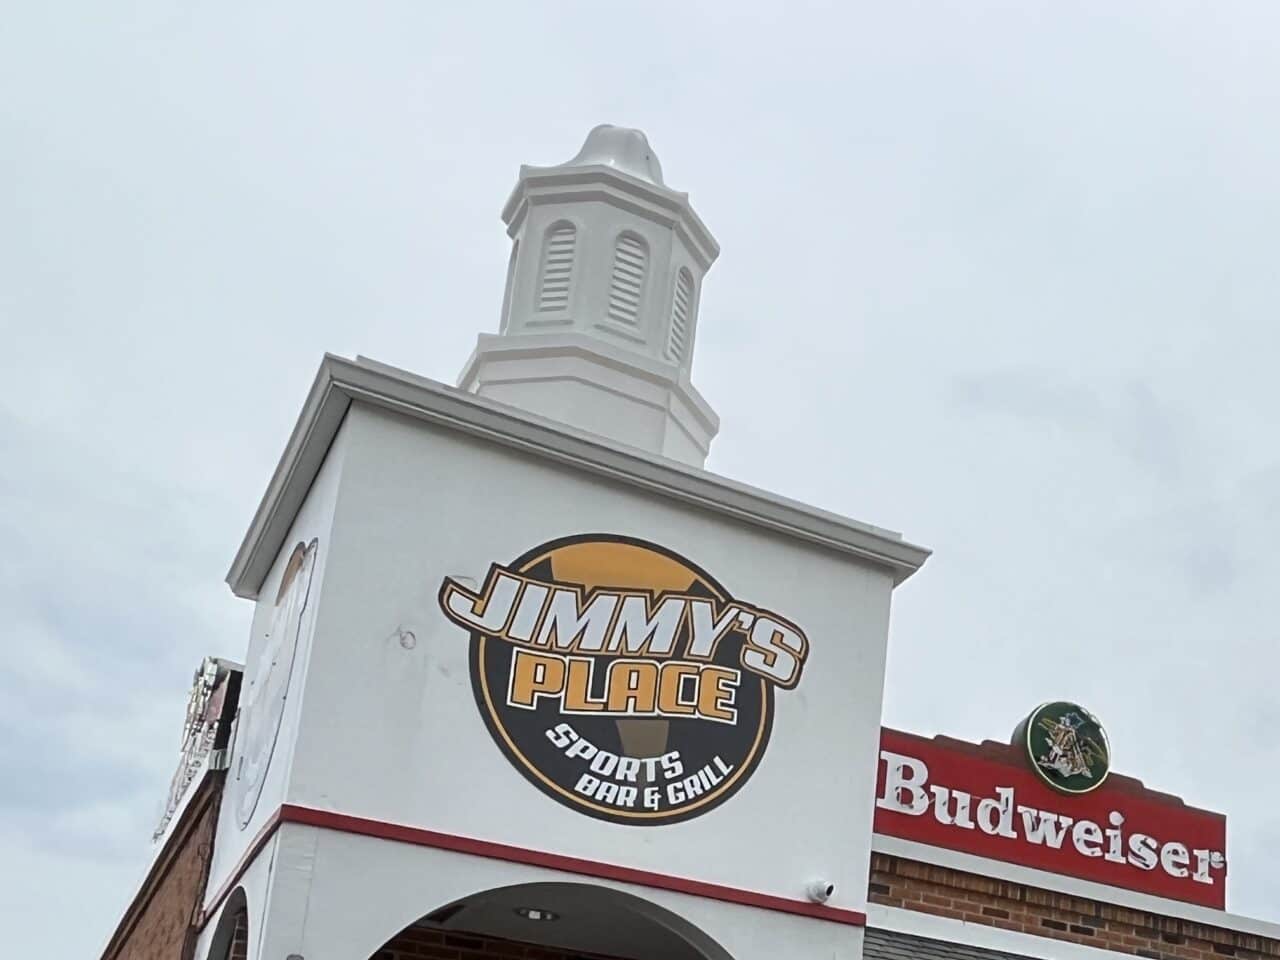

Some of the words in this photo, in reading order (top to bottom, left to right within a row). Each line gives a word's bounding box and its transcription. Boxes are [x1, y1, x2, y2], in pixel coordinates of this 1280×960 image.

[440, 564, 808, 689] JIMMY'S
[507, 647, 740, 726] PLACE
[545, 722, 684, 783] SPORTS
[574, 773, 639, 809] BAR
[644, 787, 663, 811] &
[667, 755, 735, 806] GRILL
[876, 749, 1225, 885] Budweiser
